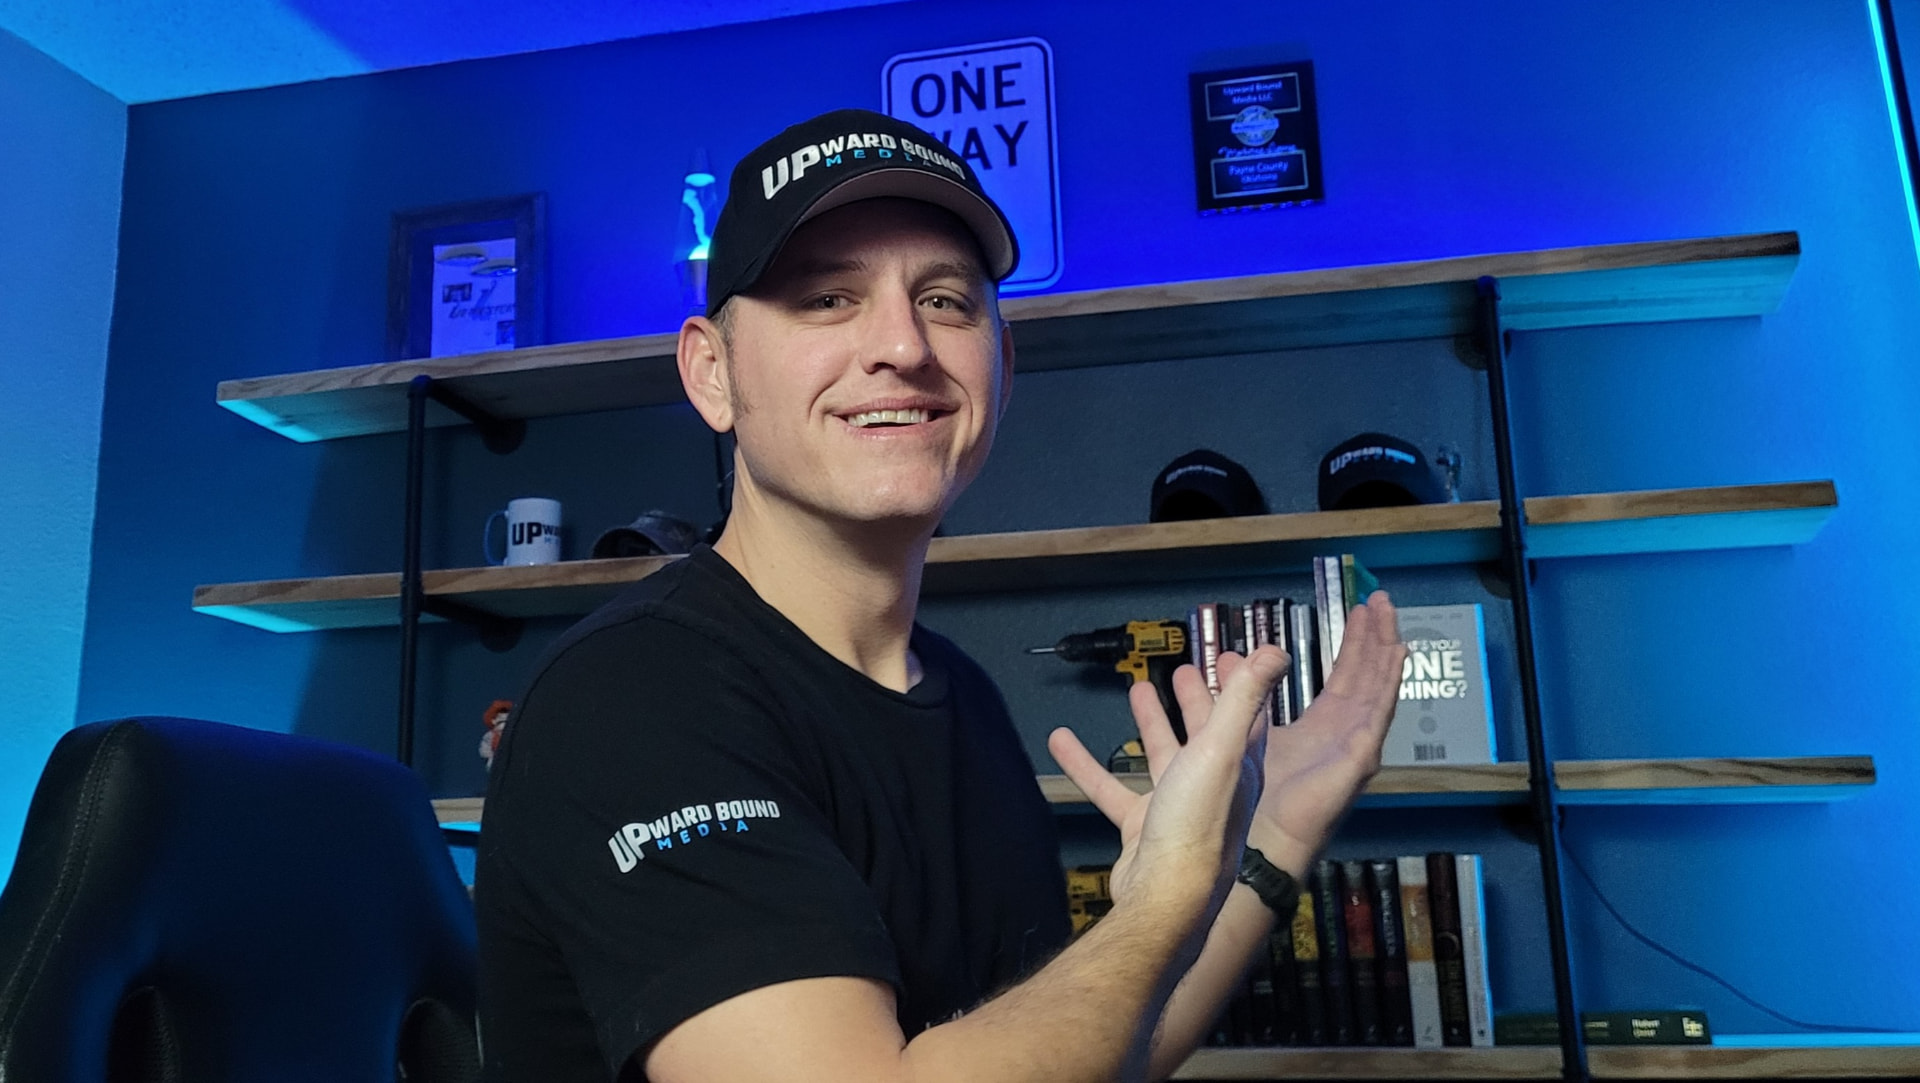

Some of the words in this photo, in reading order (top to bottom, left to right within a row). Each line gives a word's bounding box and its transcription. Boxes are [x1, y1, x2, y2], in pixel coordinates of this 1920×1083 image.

[911, 62, 1026, 118] ONE
[761, 133, 897, 200] UPWARD
[900, 138, 967, 181] BOUND
[826, 149, 932, 168] MEDIA
[1399, 679, 1469, 701] HING?
[607, 804, 713, 873] UPWARD
[714, 800, 781, 821] BOUND
[657, 820, 749, 850] MEDIA
